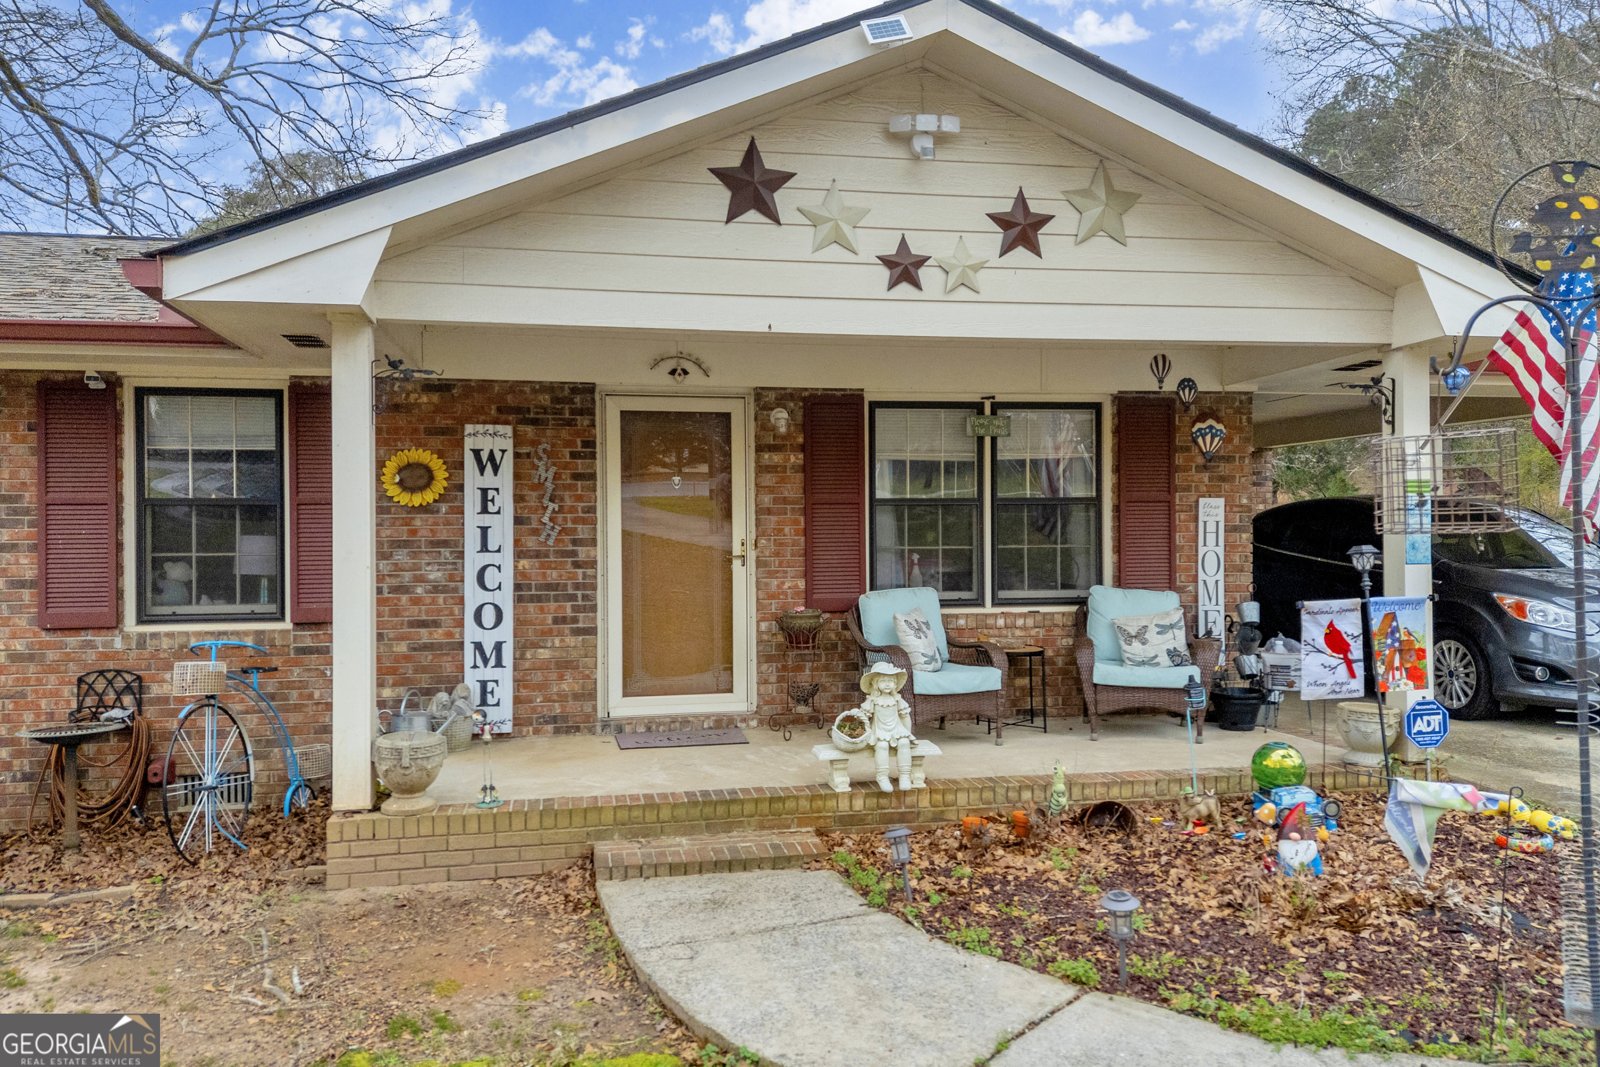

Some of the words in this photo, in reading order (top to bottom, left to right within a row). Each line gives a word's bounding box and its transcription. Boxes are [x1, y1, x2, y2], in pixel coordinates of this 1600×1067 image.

[533, 443, 562, 546] SMITH
[469, 448, 508, 708] WELCOME
[1201, 520, 1222, 637] HOME
[1371, 601, 1422, 613] Welcome
[1413, 715, 1442, 733] ADT
